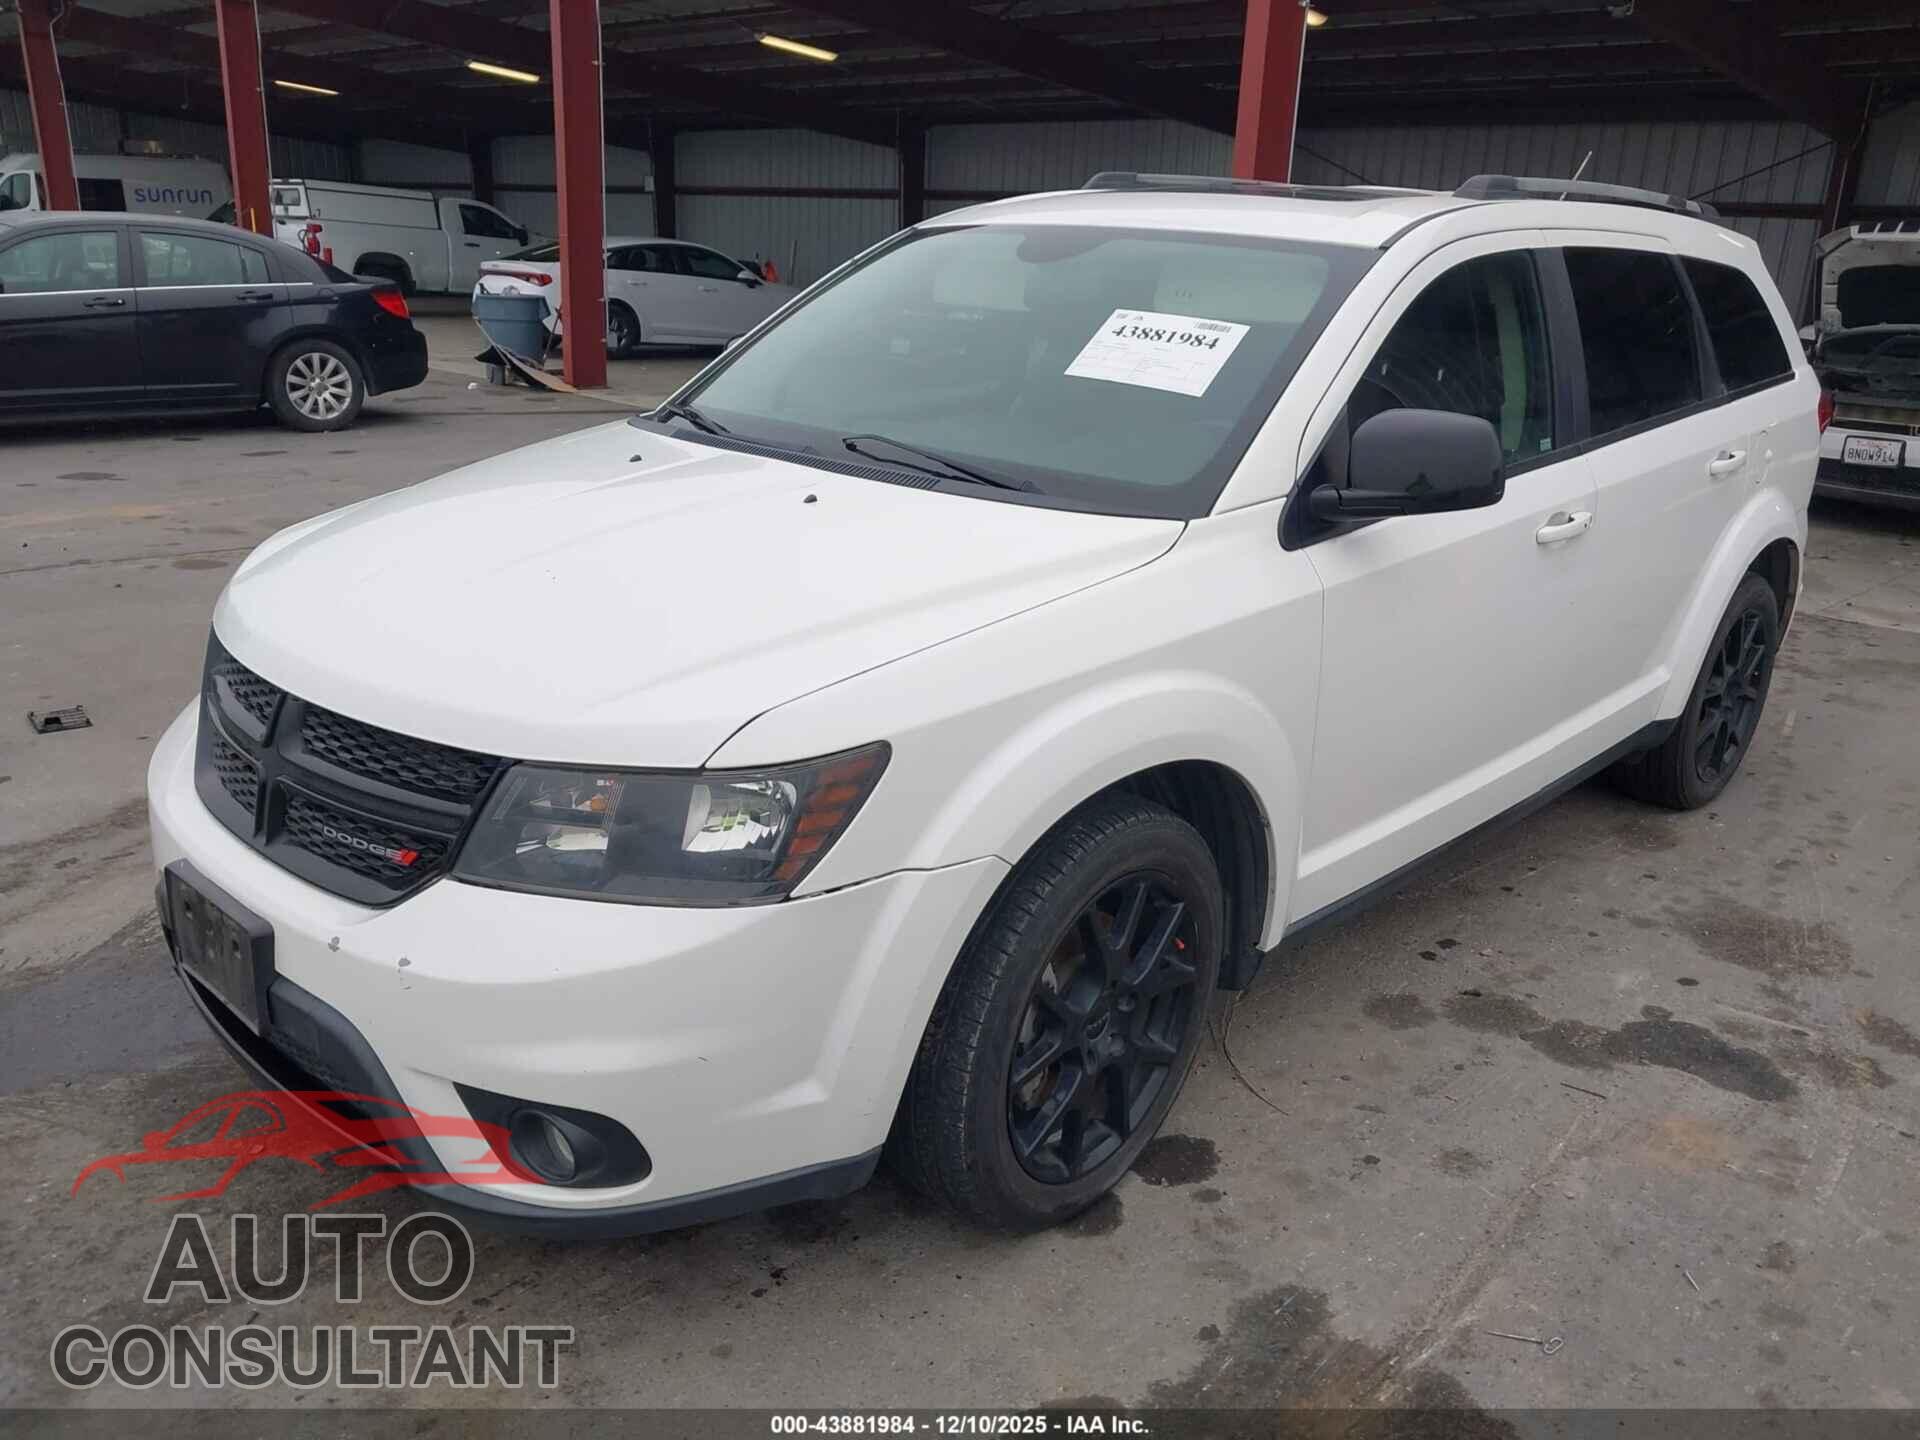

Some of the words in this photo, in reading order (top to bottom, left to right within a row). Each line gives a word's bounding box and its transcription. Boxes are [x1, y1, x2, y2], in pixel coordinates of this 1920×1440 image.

[134, 187, 212, 204] sunrun
[1112, 324, 1220, 351] 43881984
[323, 826, 403, 862] DODGE
